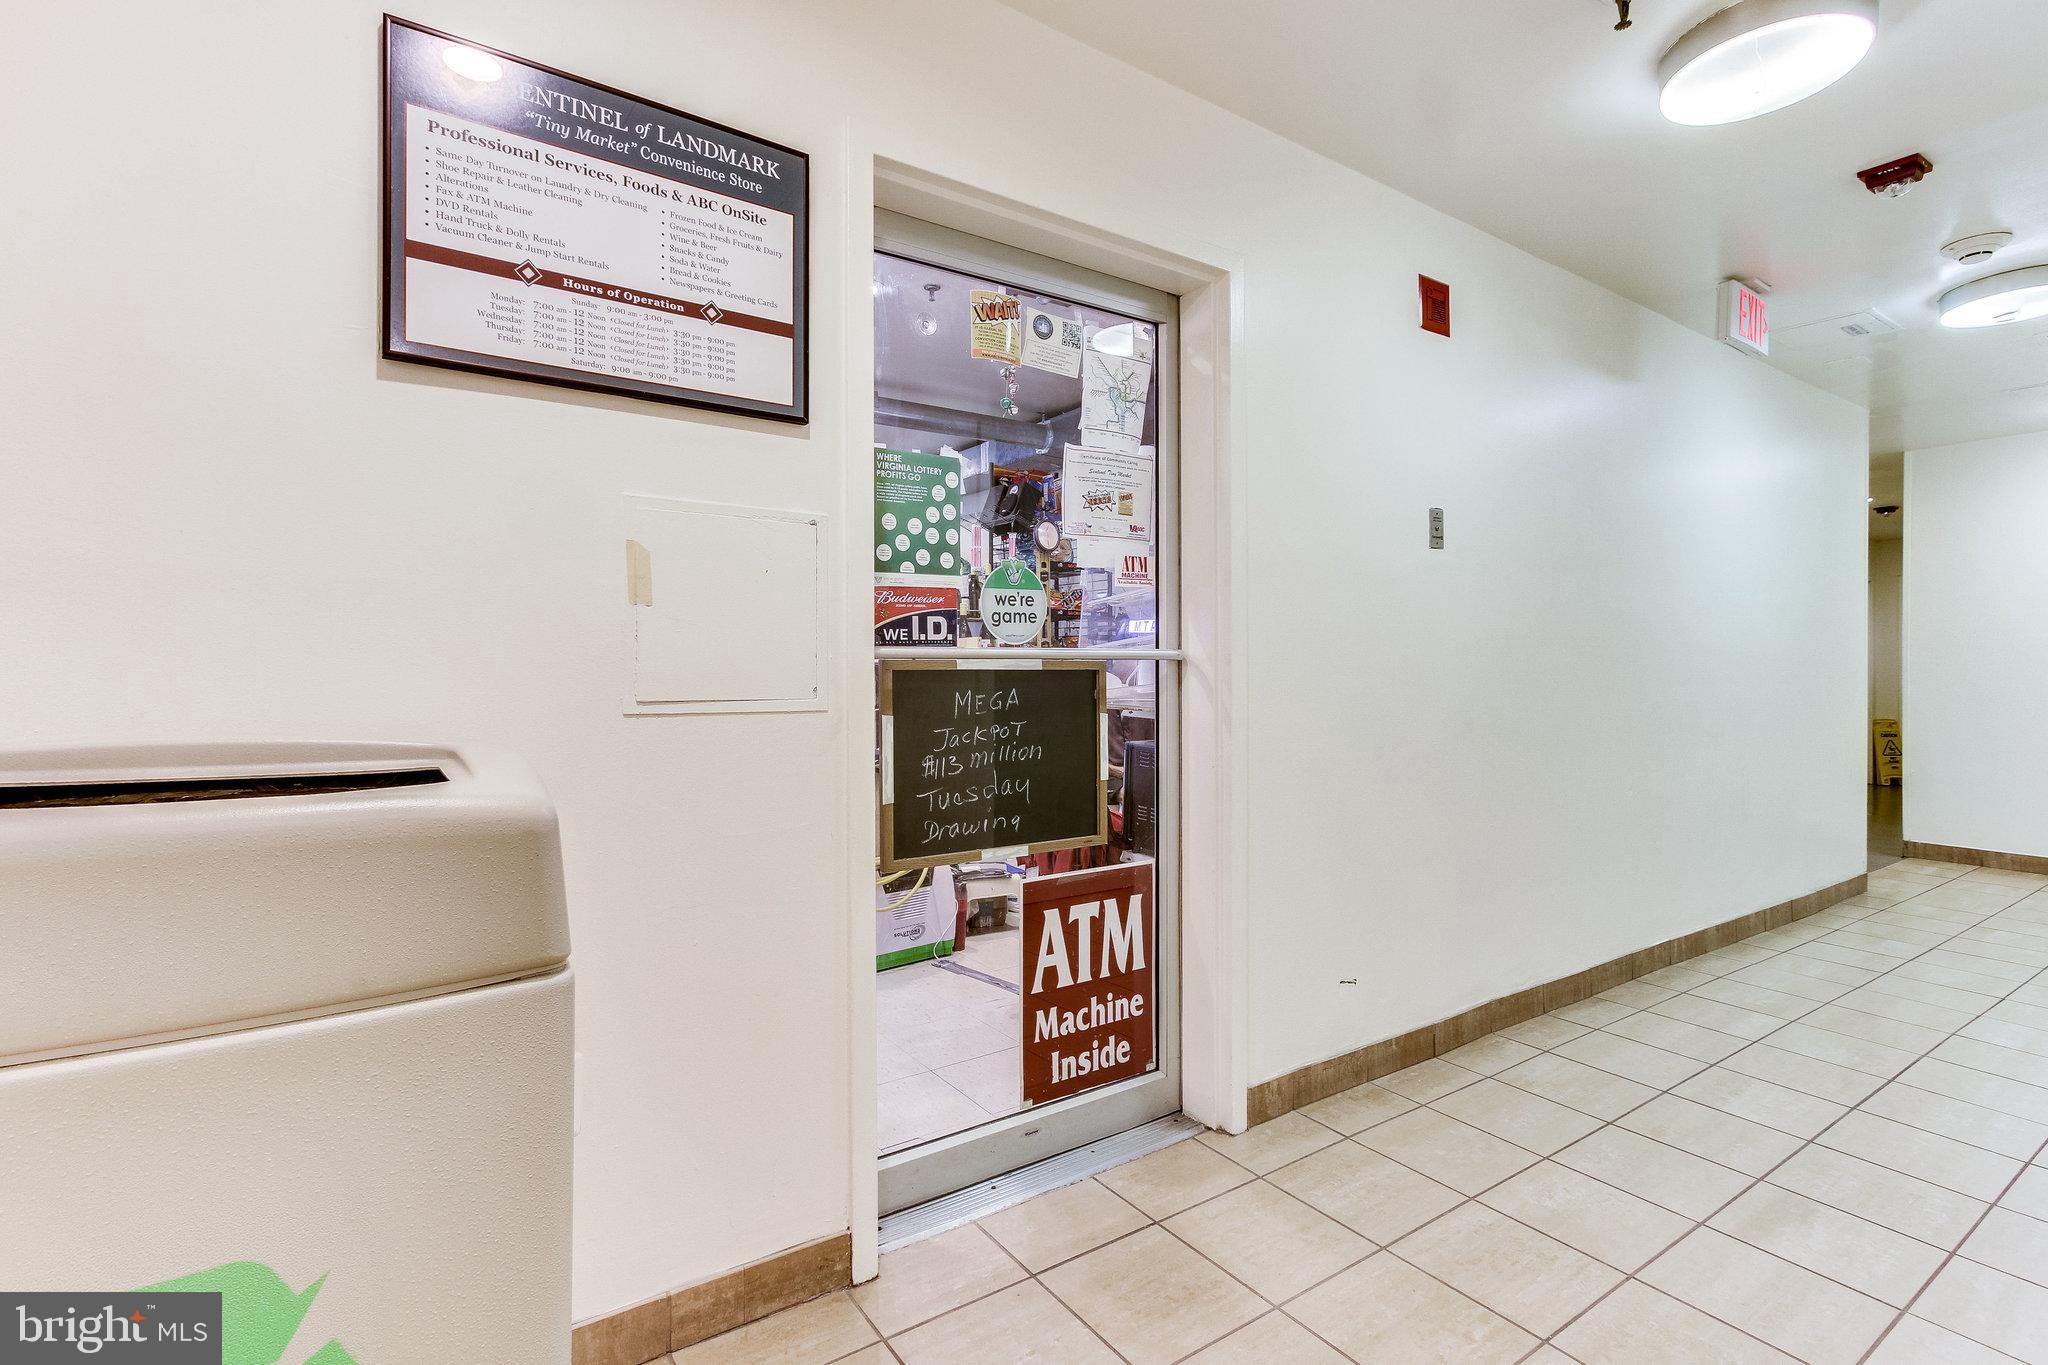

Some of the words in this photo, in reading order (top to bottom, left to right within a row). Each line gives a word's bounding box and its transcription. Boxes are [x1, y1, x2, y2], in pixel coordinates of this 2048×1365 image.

[520, 81, 628, 132] ENTINEL
[635, 120, 652, 140] of
[657, 125, 780, 179] LANDMARK
[428, 119, 539, 162] Professional
[544, 152, 618, 188] Services,
[623, 174, 667, 198] Foods
[671, 188, 682, 202] &
[686, 192, 718, 212] ABC
[721, 202, 766, 225] OnSite
[435, 147, 462, 161] Same
[466, 155, 484, 169] Day
[487, 161, 528, 179] Turnover
[545, 176, 582, 195] Laundry
[584, 187, 591, 196] &
[594, 190, 610, 203] Dry
[611, 194, 648, 213] Cleaning
[435, 172, 489, 193] Alterations
[435, 159, 459, 173] Shoe
[462, 166, 494, 182] Repair
[496, 175, 504, 185] &
[507, 178, 542, 194] Leather
[544, 188, 583, 207] Cleaning
[640, 145, 725, 183] Convenience
[729, 172, 762, 194] Store
[435, 185, 454, 196] Fax
[456, 190, 463, 199] &
[466, 192, 490, 205] ATM
[493, 199, 533, 216] Machine
[435, 197, 459, 210] DVD
[463, 204, 499, 220] Rentals
[435, 210, 462, 224] Hand
[465, 217, 493, 231] Truck
[495, 224, 503, 233] &
[506, 227, 529, 241] Dolly
[533, 233, 566, 248] Rentals
[669, 222, 707, 240] Groceries,
[710, 232, 730, 244] Fresh
[732, 238, 754, 250] Fruits
[755, 244, 761, 252] &
[763, 246, 783, 260] Dairy
[669, 233, 690, 245] Wine
[692, 239, 698, 247] &
[700, 241, 717, 251] Beer
[670, 211, 695, 224] Frozen
[698, 218, 716, 230] Food
[718, 224, 725, 232] &
[726, 226, 737, 235] Ice
[739, 229, 762, 242] Cream
[435, 222, 474, 239] Vacuum
[477, 232, 513, 248] Cleaner
[515, 241, 522, 250] &
[525, 243, 551, 258] Jump
[553, 250, 575, 262] Start
[578, 255, 610, 270] Rentals
[669, 244, 696, 257] Snacks
[697, 251, 704, 259] &
[706, 253, 729, 267] Candy
[669, 255, 688, 266] Soda
[690, 260, 697, 268] &
[698, 262, 721, 274] Water
[669, 266, 691, 278] Bread
[694, 272, 700, 280] &
[702, 274, 731, 287] Cookies
[562, 277, 603, 295] Hours
[607, 288, 619, 298] of
[623, 290, 684, 312] Operation
[669, 277, 715, 294] Newspapers
[716, 288, 723, 296] &
[724, 290, 755, 305] Greeting
[757, 298, 777, 308] Cards
[490, 292, 526, 307] Monday:
[533, 301, 554, 311] 7:00
[574, 309, 584, 317] 12
[587, 311, 606, 321] Noon
[635, 321, 645, 329] for
[673, 329, 691, 338] 3:30
[707, 336, 724, 345] 9:00
[571, 297, 600, 311] Sunday:
[606, 305, 625, 315] 9:00
[643, 313, 662, 322] 3:00
[974, 300, 1021, 322] WAIT!
[1739, 288, 1766, 347] EXIT
[477, 309, 525, 326] Wednesday:
[533, 320, 554, 330] 7:00
[574, 328, 584, 336] 12
[587, 330, 606, 340] Noon
[673, 347, 690, 356] 3:30
[707, 354, 724, 362] 9:00
[489, 301, 526, 317] Tuesday:
[533, 311, 554, 320] 7:00
[574, 318, 584, 326] 12
[587, 321, 606, 330] Noon
[673, 338, 690, 347] 3:30
[707, 345, 724, 353] 9:00
[485, 320, 525, 336] Thursday:
[533, 330, 554, 340] 7:00
[574, 337, 584, 345] 12
[587, 339, 605, 349] Noon
[673, 356, 690, 365] 3:30
[707, 362, 724, 371] 9:00
[497, 333, 525, 346] Friday:
[533, 340, 554, 349] 7:00
[574, 347, 584, 355] 12
[587, 349, 605, 358] Noon
[673, 365, 690, 374] 3:30
[707, 371, 724, 379] 9:00
[571, 357, 606, 371] Saturday:
[611, 365, 630, 374] 9:00
[648, 371, 666, 380] 9:00
[876, 453, 903, 463] WHERE
[876, 461, 912, 473] VIRGINIA
[913, 466, 943, 476] LOTTERY
[876, 470, 907, 480] PROFITS
[908, 473, 921, 482] GO
[1122, 555, 1149, 573] ATM
[875, 590, 945, 604] Budweiser
[884, 629, 909, 641] WE
[912, 616, 953, 641] I.D.
[992, 611, 1038, 627] game
[954, 688, 1020, 719] MEGA
[922, 754, 964, 780] $113
[970, 741, 1042, 769] million
[916, 768, 1031, 812] Tuesday
[922, 806, 1021, 844] Drawing
[894, 928, 921, 938] SOLUTIONS
[1030, 893, 1147, 996] ATM
[1034, 993, 1144, 1044] Machine
[1051, 1036, 1131, 1085] Inside
